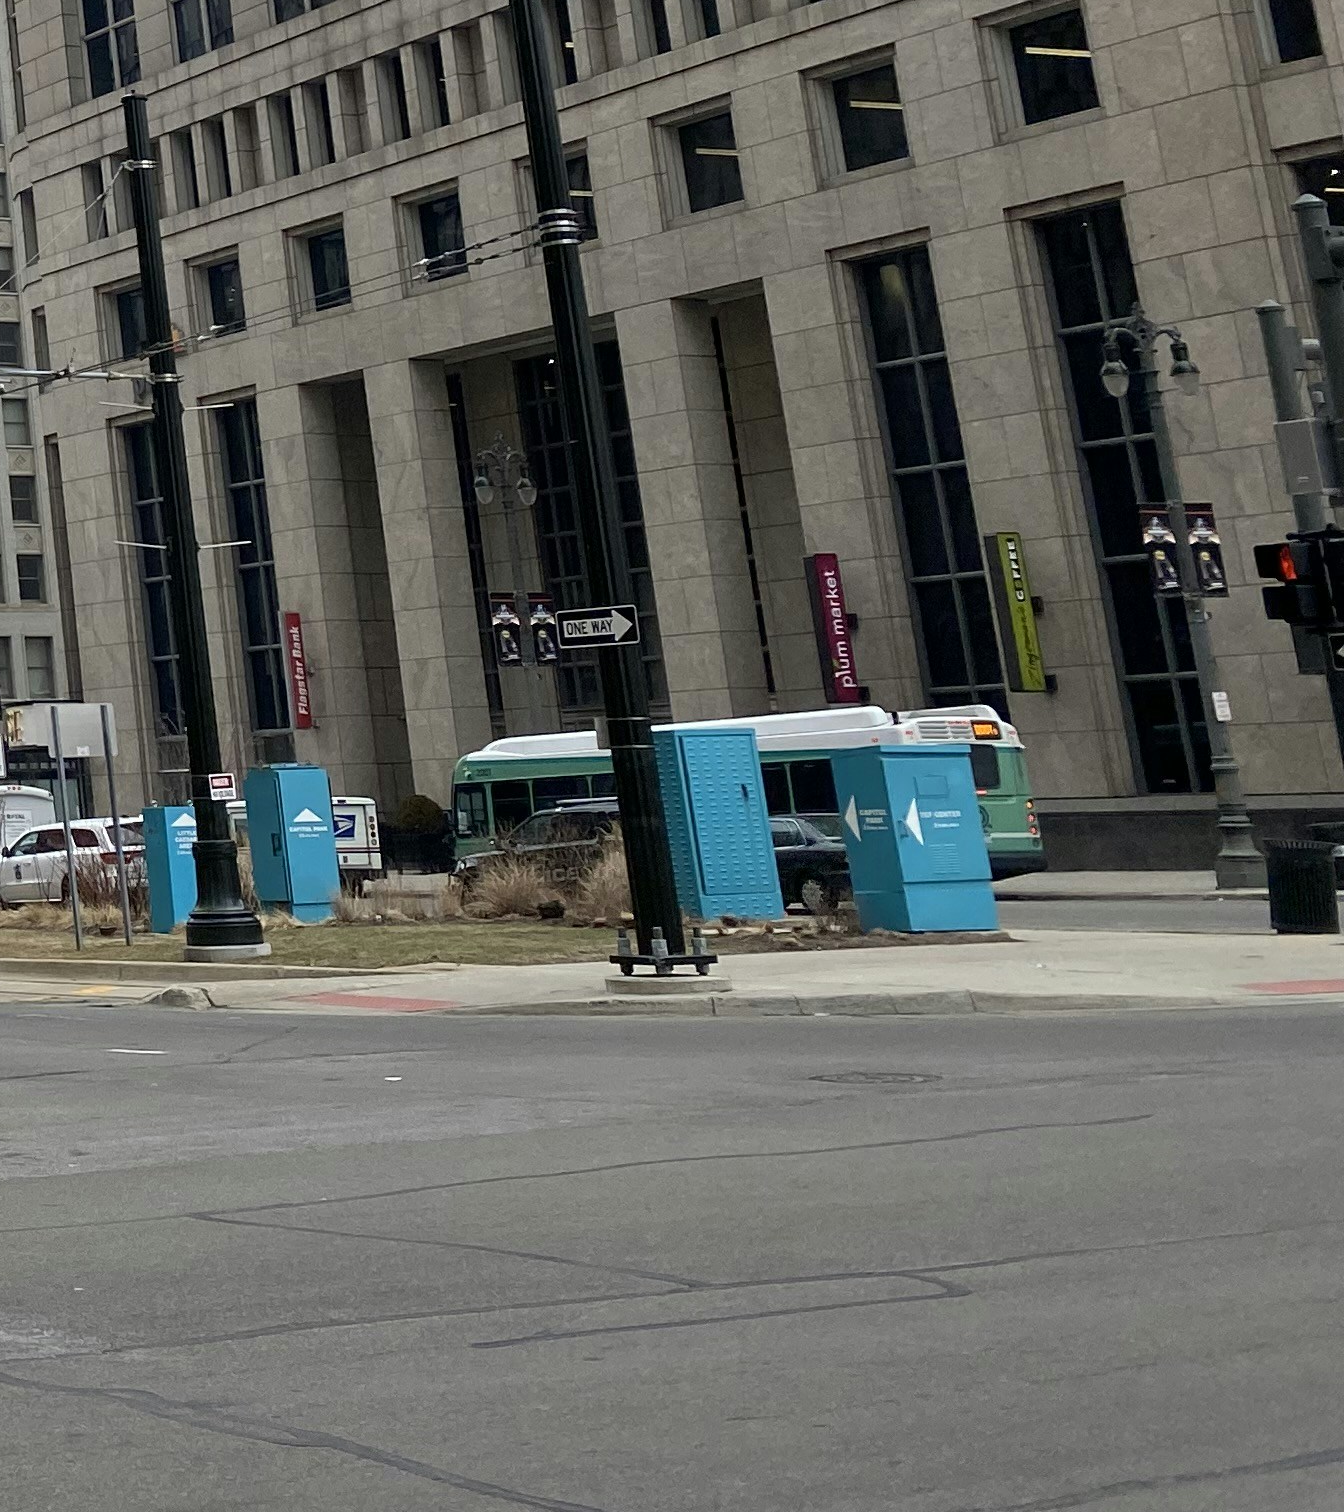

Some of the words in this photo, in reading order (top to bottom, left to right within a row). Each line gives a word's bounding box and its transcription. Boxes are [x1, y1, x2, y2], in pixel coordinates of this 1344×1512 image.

[824, 570, 846, 635] market
[290, 626, 302, 659] Bank
[566, 621, 589, 636] ONE
[591, 619, 613, 634] WAY
[295, 660, 309, 715] Flagstar
[835, 640, 858, 688] plum
